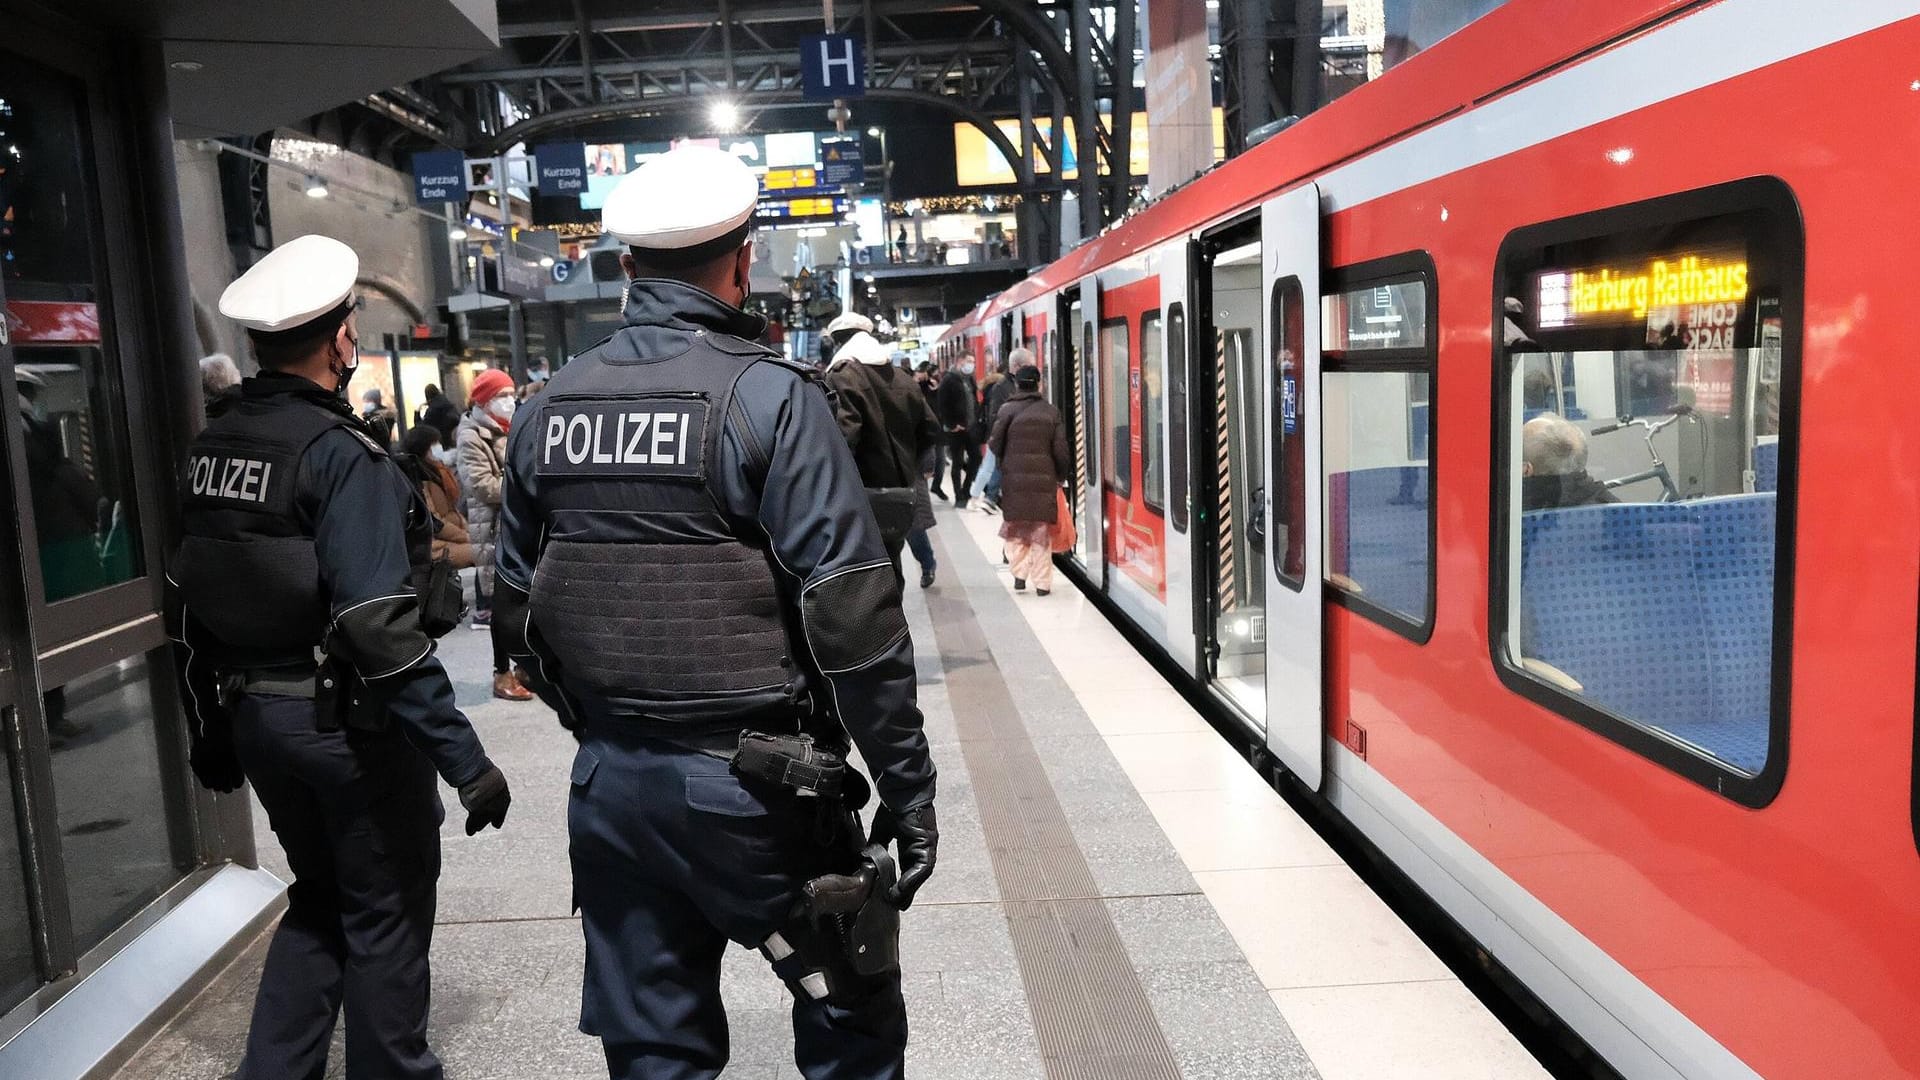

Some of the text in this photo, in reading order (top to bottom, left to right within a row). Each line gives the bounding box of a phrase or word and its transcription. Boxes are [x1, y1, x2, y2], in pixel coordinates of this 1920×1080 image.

[820, 38, 855, 88] H
[421, 174, 459, 186] Kurzzug
[543, 166, 581, 178] Kurzzug
[422, 187, 446, 199] Ende
[558, 178, 582, 190] Ende
[856, 248, 870, 265] G
[553, 263, 569, 282] G
[1570, 268, 1649, 319] Harburg
[1653, 256, 1748, 306] Rathaus
[543, 413, 690, 465] POLIZEI
[187, 455, 272, 503] POLIZEI
